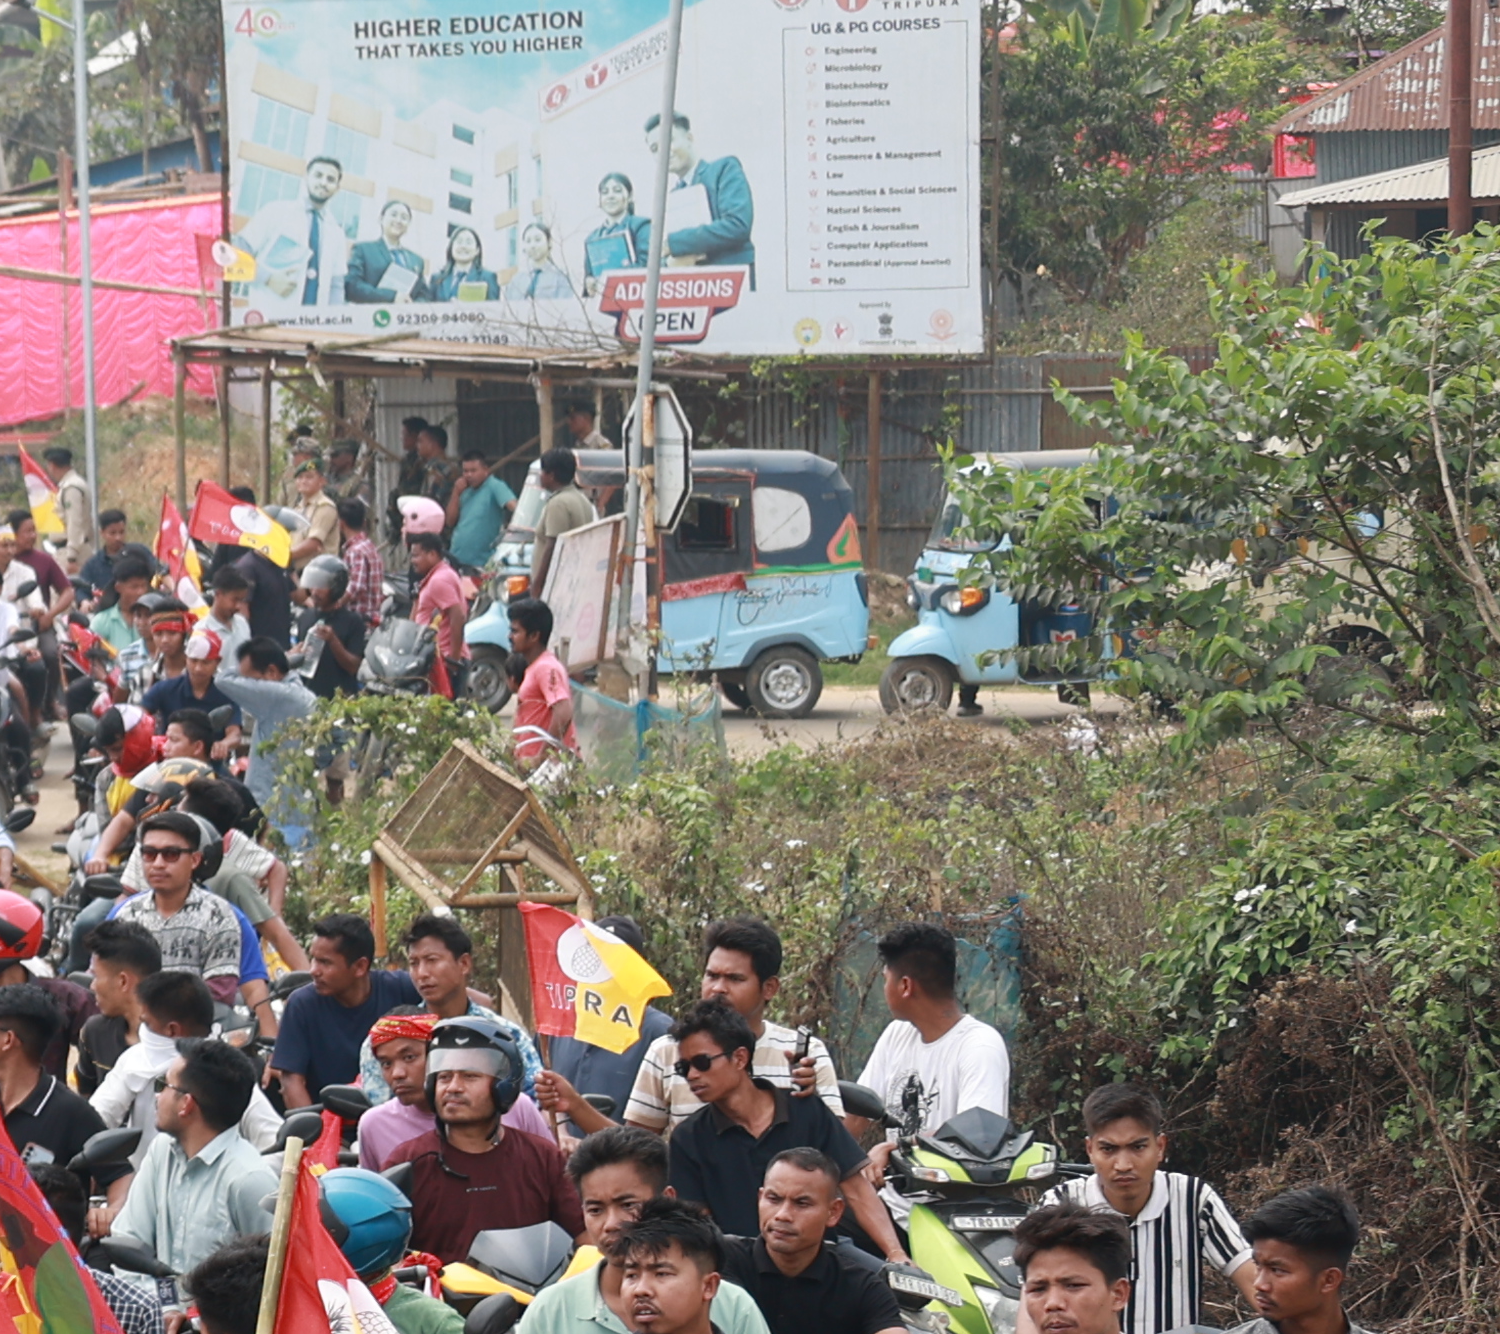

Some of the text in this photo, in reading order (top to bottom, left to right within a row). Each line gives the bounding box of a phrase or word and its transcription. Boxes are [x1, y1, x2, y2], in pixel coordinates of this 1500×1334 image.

[354, 10, 584, 39] HIGHER EDUCATION
[811, 17, 941, 34] UG & PG COURSES
[356, 35, 584, 60] THAT TAKES YOU HIGHER
[824, 46, 877, 55] Engineering
[824, 63, 882, 73] Microbiology
[825, 81, 889, 90] Biotechnology
[825, 99, 891, 108] Bioinformatics
[825, 117, 865, 126] Fisheries
[826, 134, 876, 145] Agriculture
[826, 150, 942, 161] Commerce & Management
[826, 171, 843, 179] Law
[826, 185, 957, 197] Humanities & Social Sciences
[827, 205, 901, 214] Natural Sciences
[827, 222, 920, 233] English & Journalism
[827, 240, 928, 250] Computer Applications
[827, 259, 882, 267] Paramedical
[828, 277, 846, 285] PhD
[615, 278, 734, 301] ADISSIONS
